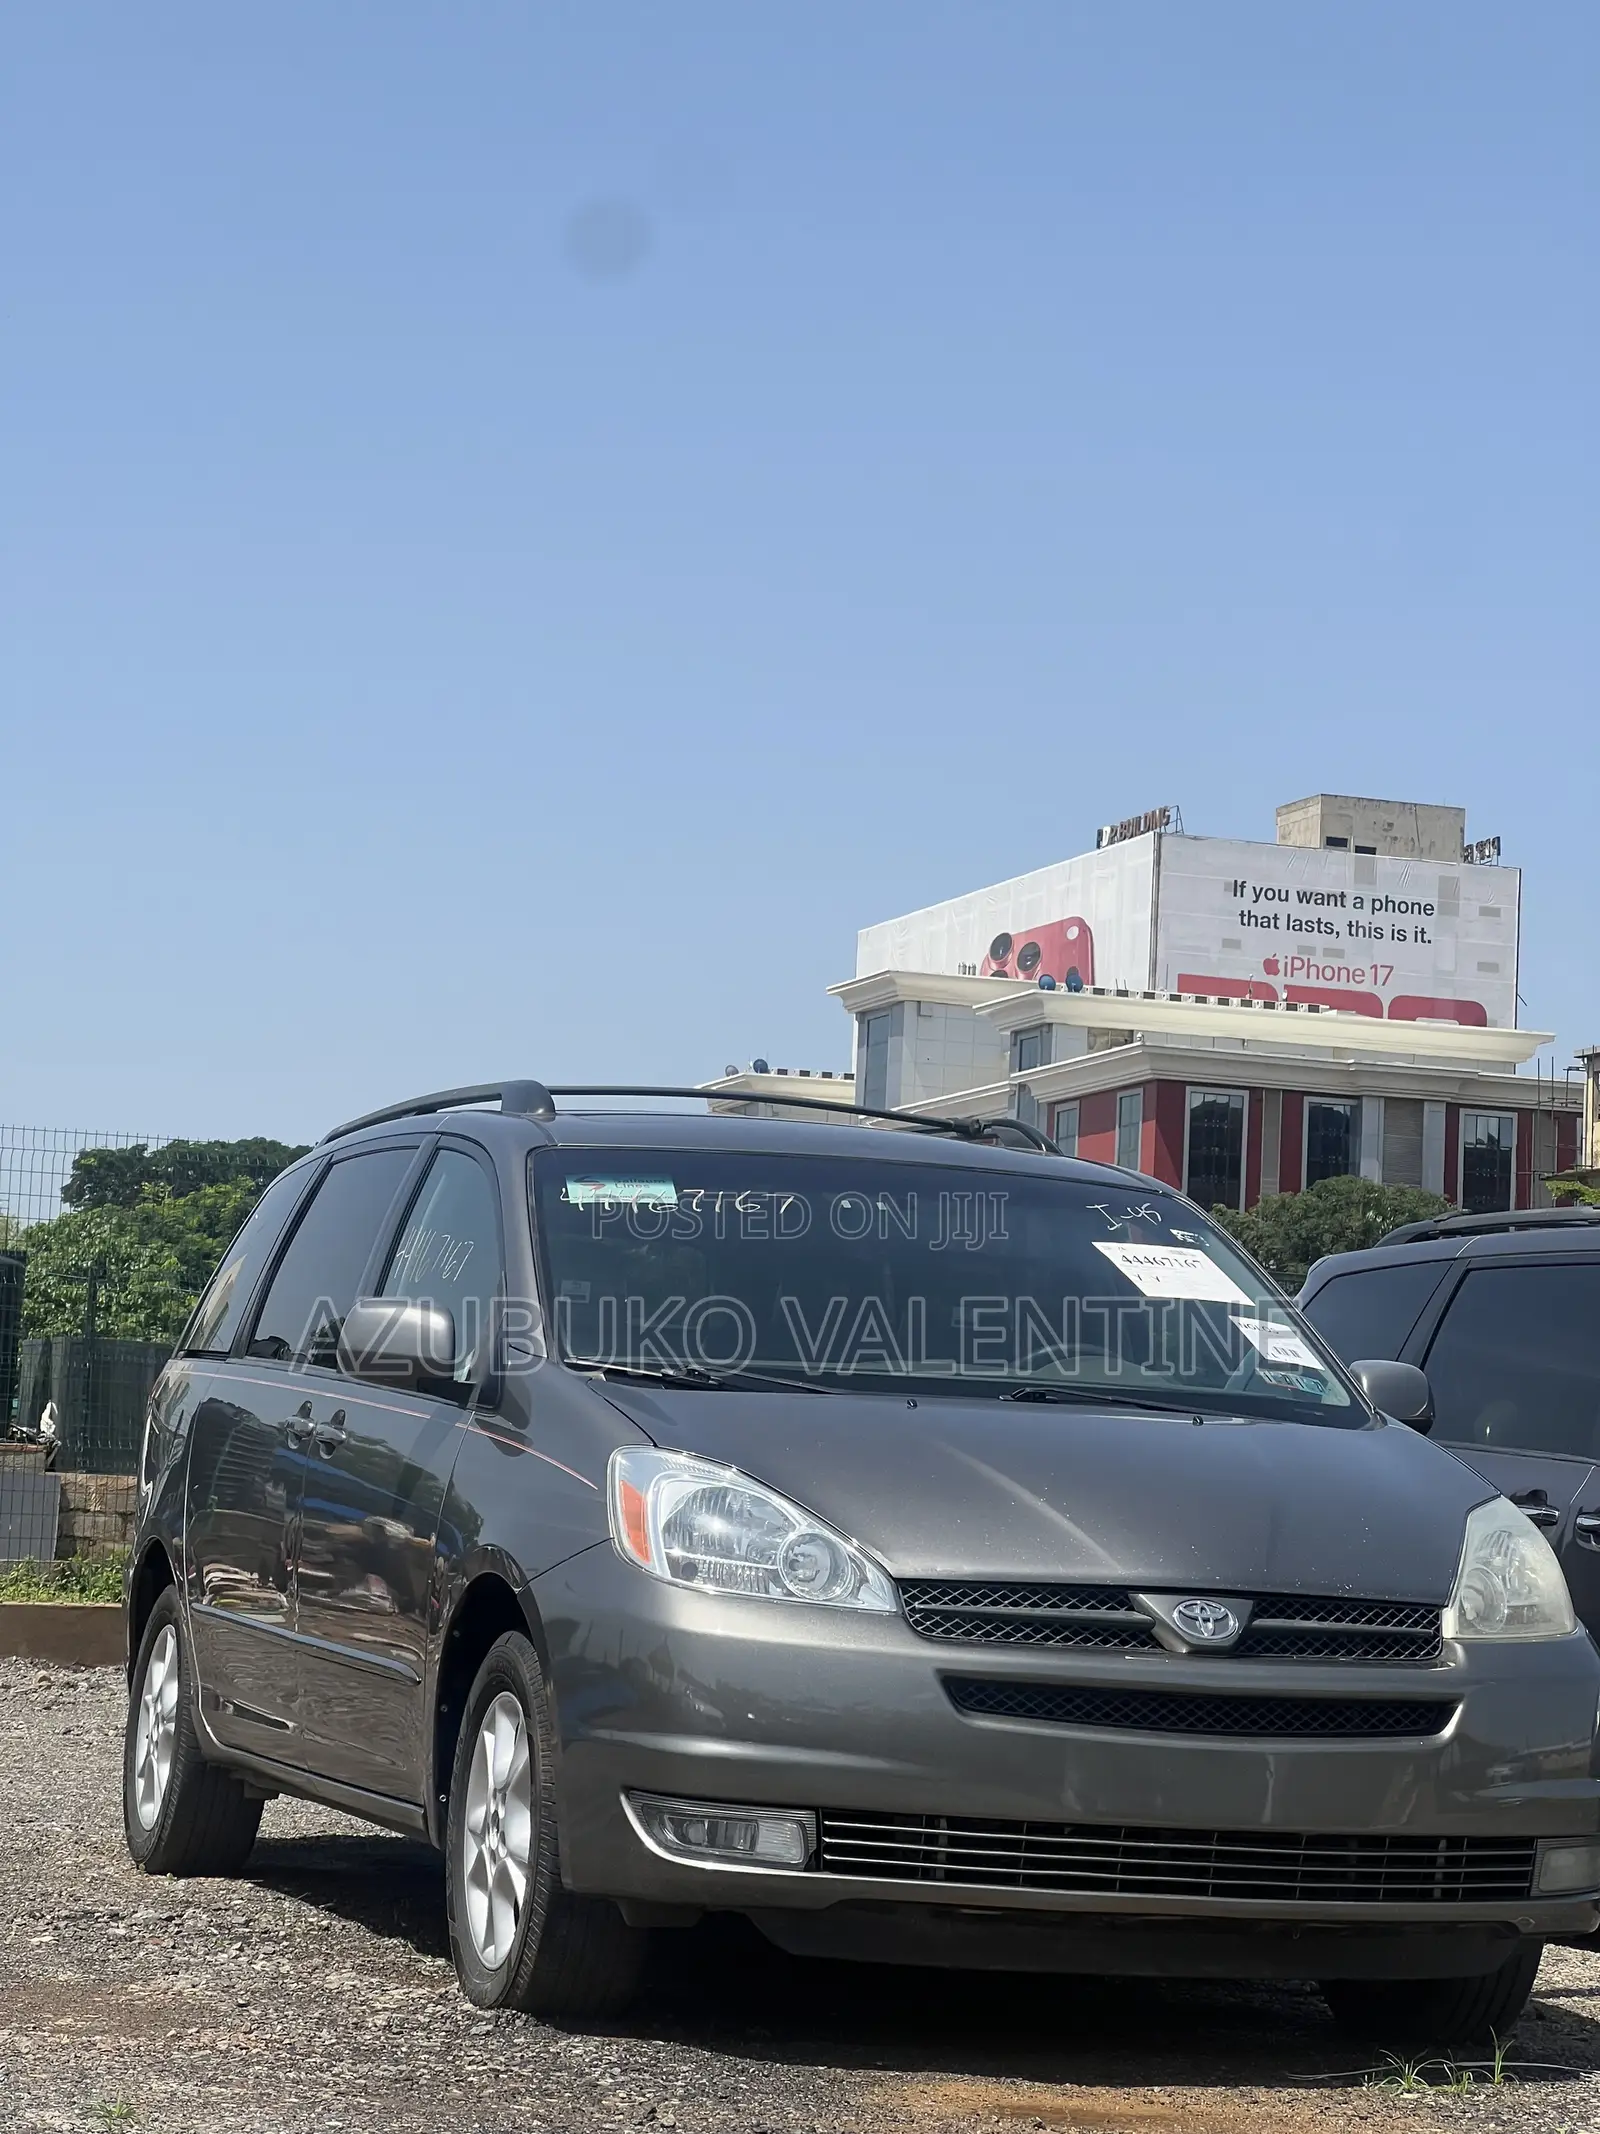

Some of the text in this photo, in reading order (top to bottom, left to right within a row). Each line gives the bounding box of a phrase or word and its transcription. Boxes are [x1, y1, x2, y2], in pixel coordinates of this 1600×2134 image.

[1120, 805, 1171, 842] BUILDING
[1233, 879, 1435, 917] If you want a phone
[1239, 910, 1432, 944] that lasts, this is it.
[1283, 955, 1395, 986] iPhone 17
